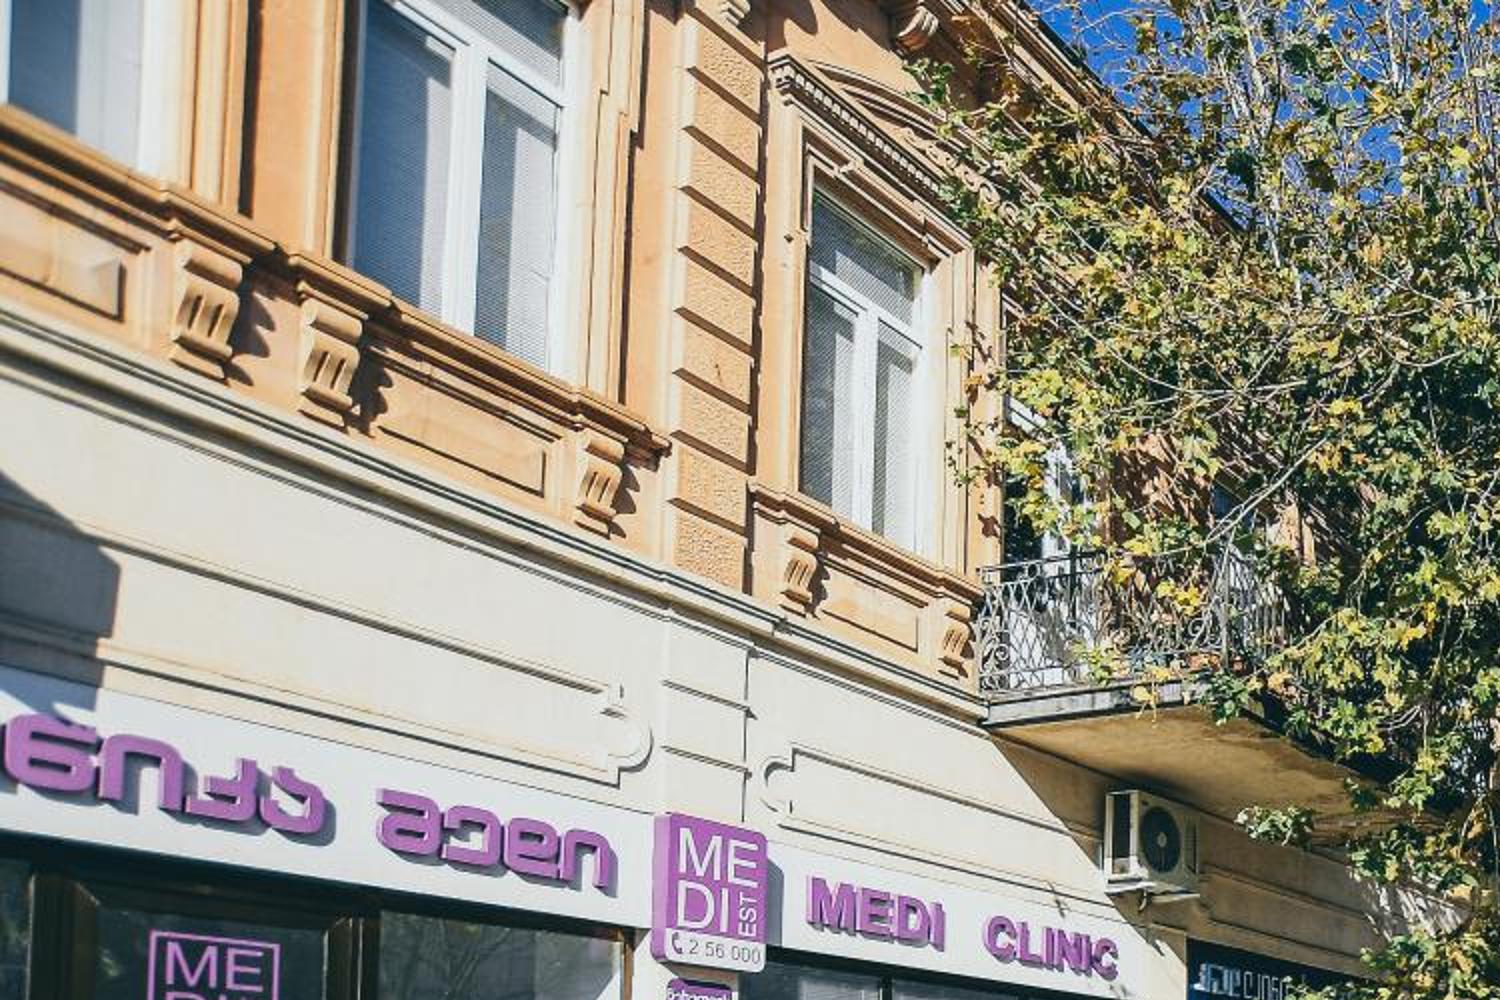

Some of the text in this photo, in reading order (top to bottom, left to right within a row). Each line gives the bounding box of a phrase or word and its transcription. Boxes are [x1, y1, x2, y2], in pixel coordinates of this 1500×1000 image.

[377, 788, 609, 889] მედი
[678, 827, 759, 888] ME
[677, 880, 729, 933] DI
[738, 891, 758, 937] EST
[806, 876, 1119, 981] MEDI CLINIC
[166, 941, 264, 992] ME
[689, 938, 761, 965] 2 56 000
